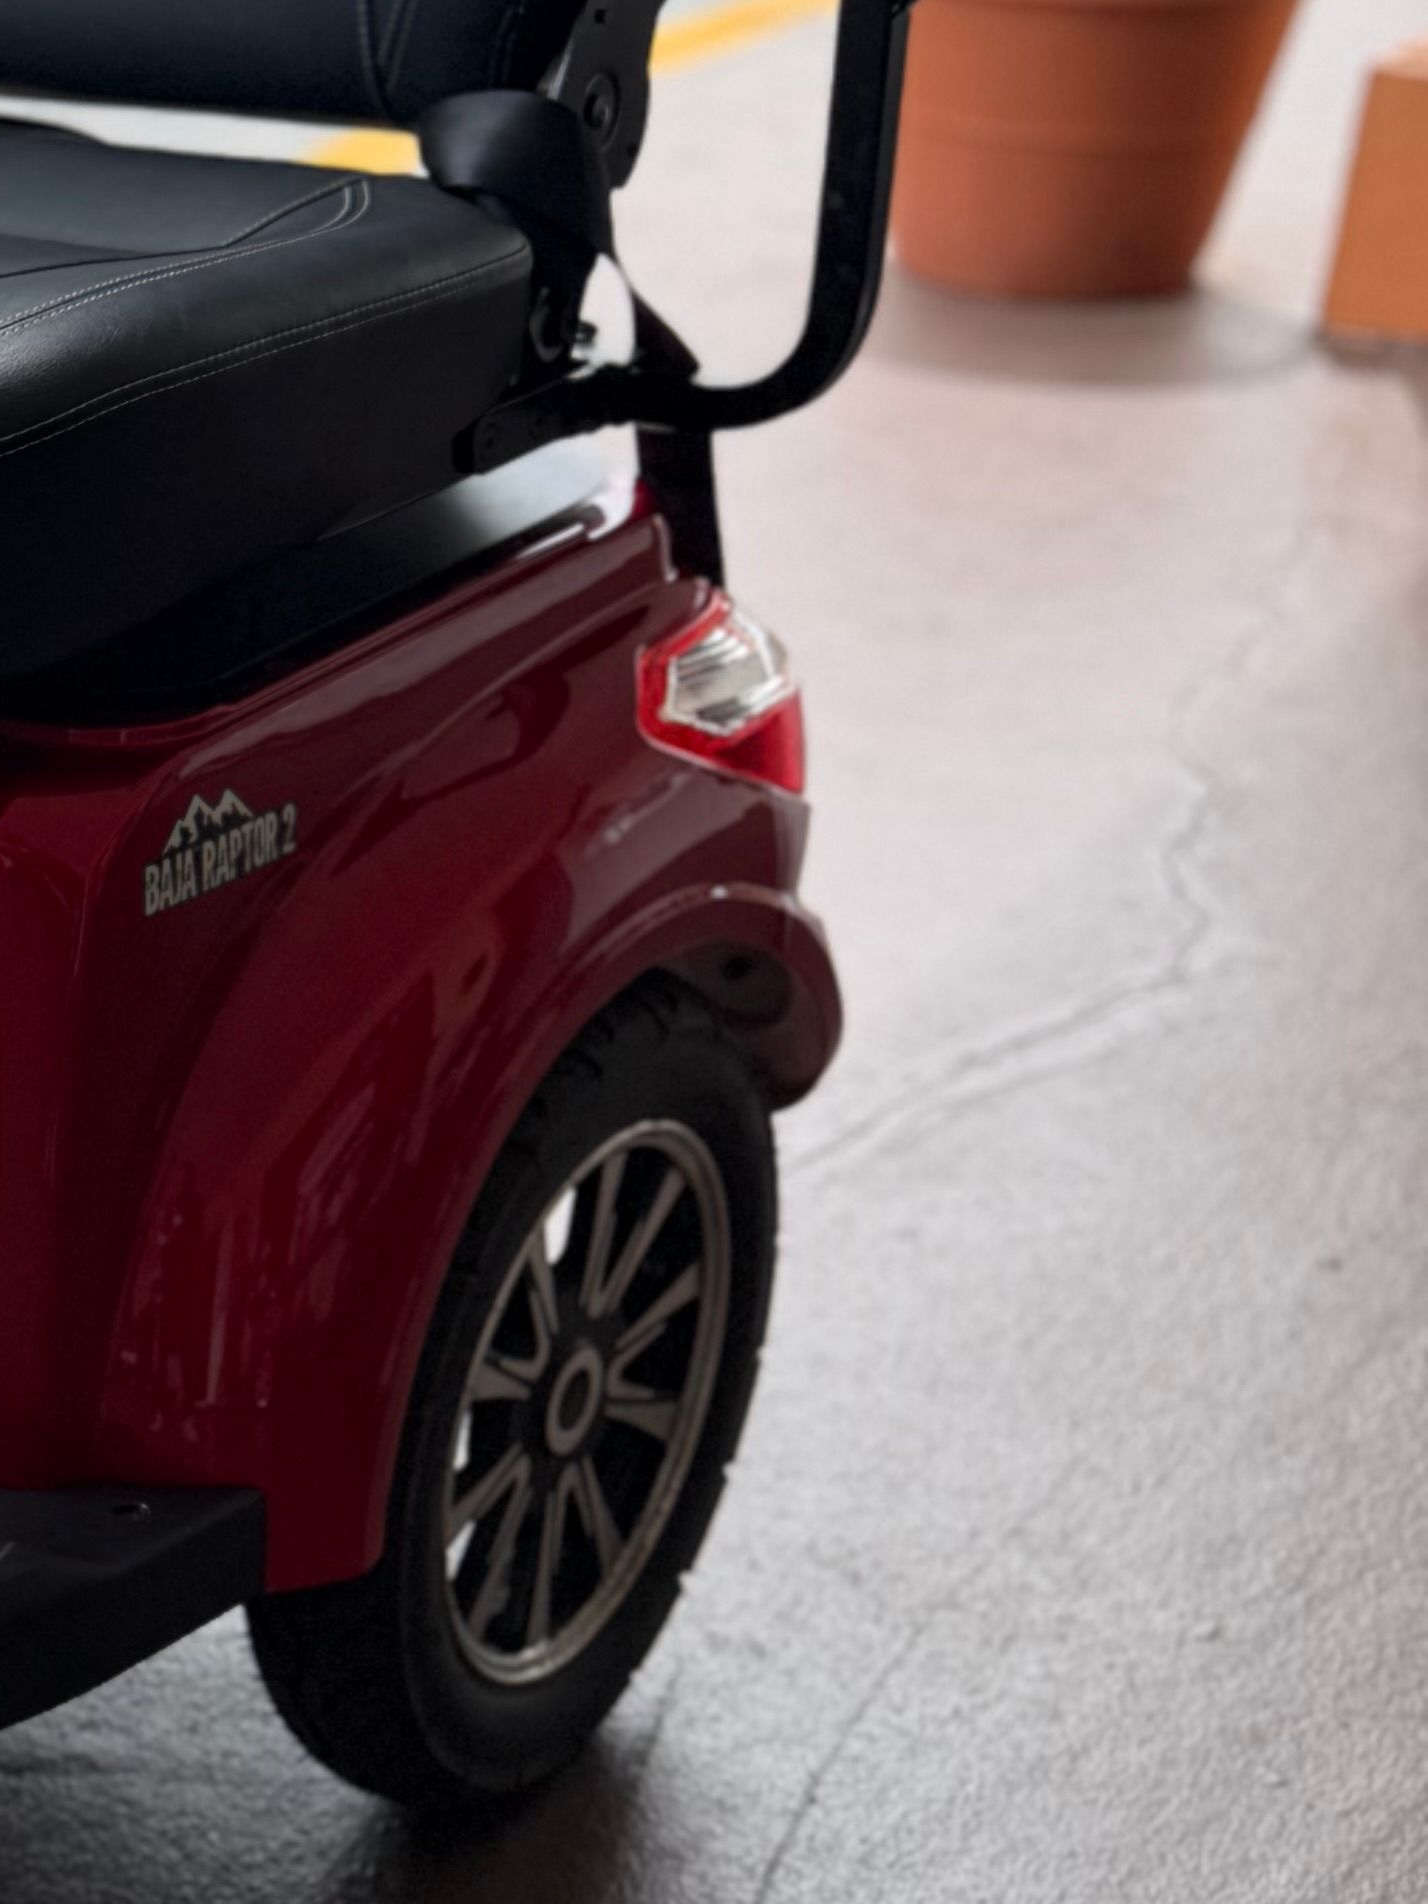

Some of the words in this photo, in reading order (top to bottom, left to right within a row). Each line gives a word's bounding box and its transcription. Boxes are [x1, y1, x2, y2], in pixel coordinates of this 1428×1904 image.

[145, 846, 196, 916] BAJA
[202, 811, 278, 891] RAPTOR
[282, 802, 296, 855] 2
